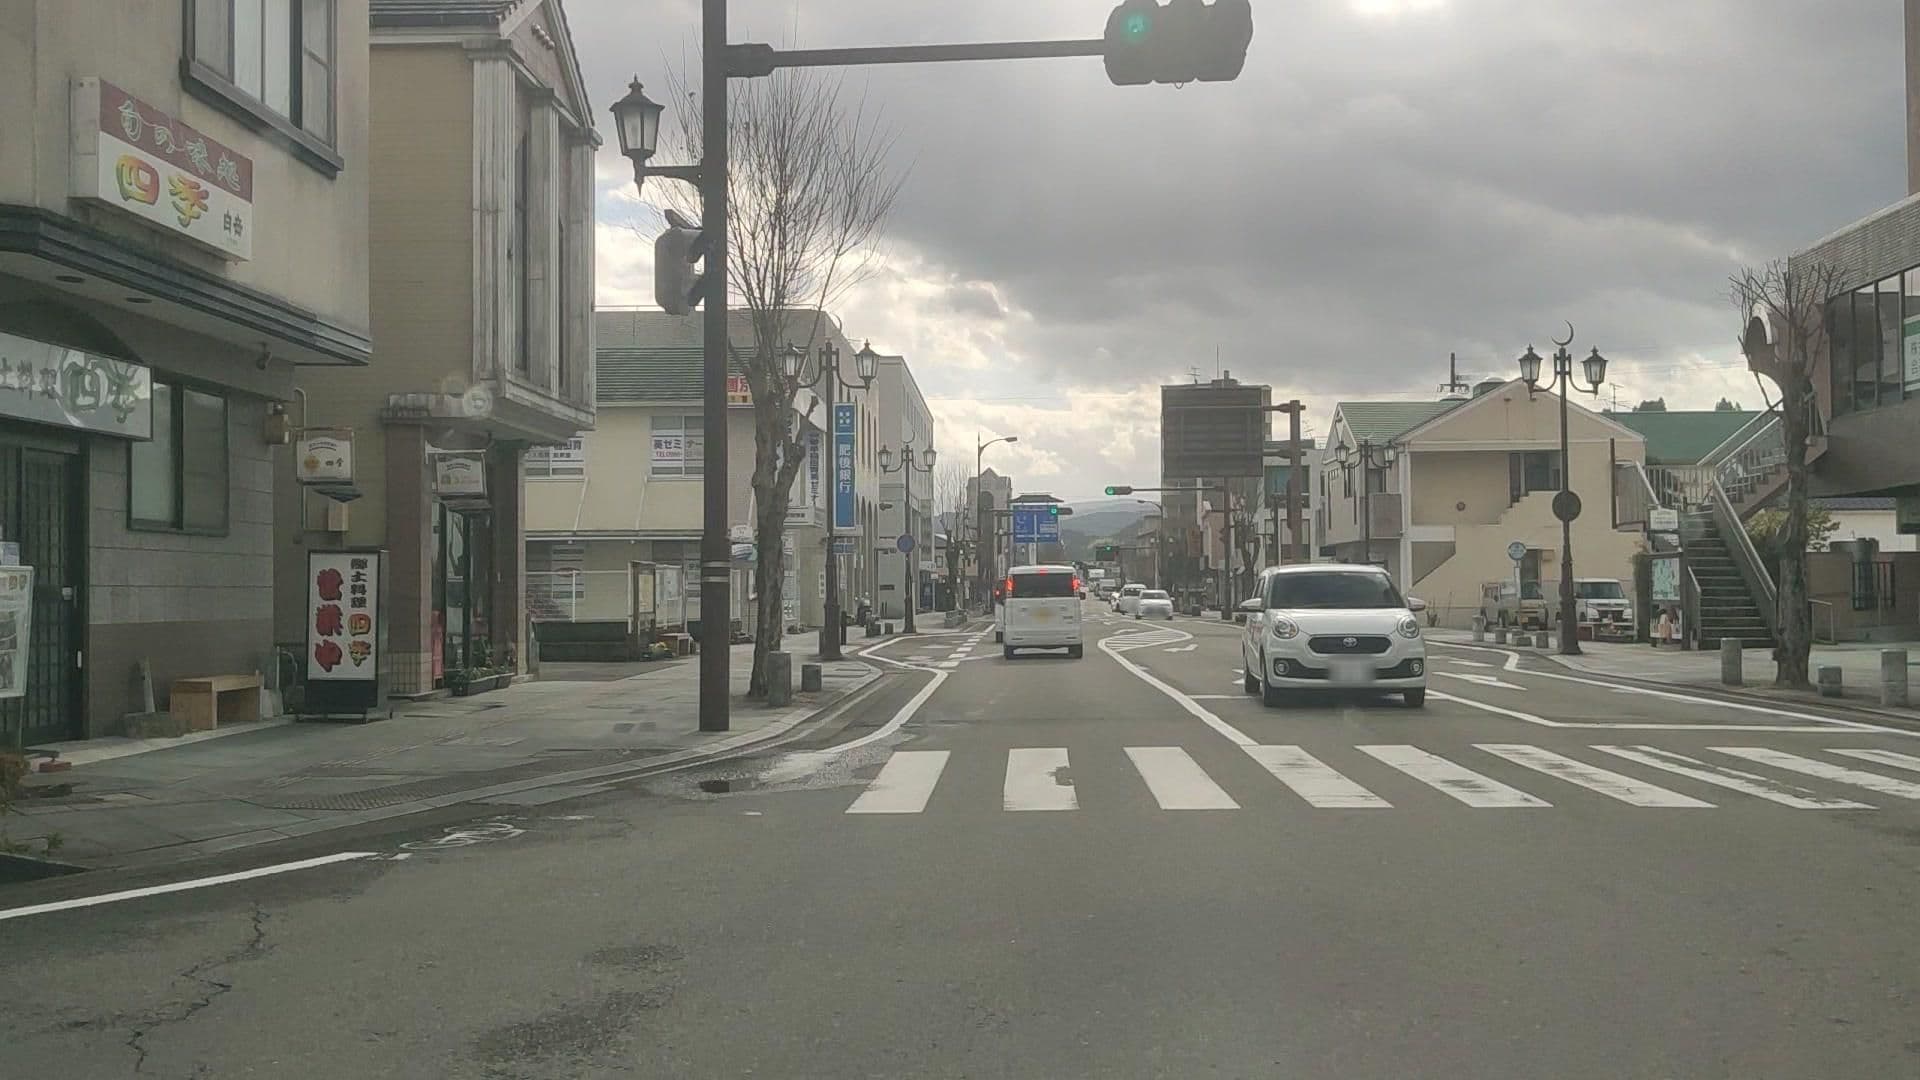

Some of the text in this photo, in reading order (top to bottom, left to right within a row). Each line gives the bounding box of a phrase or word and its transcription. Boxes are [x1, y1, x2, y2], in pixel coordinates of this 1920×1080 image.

[116, 155, 210, 228] 四季
[839, 443, 852, 494] 肥後銀行
